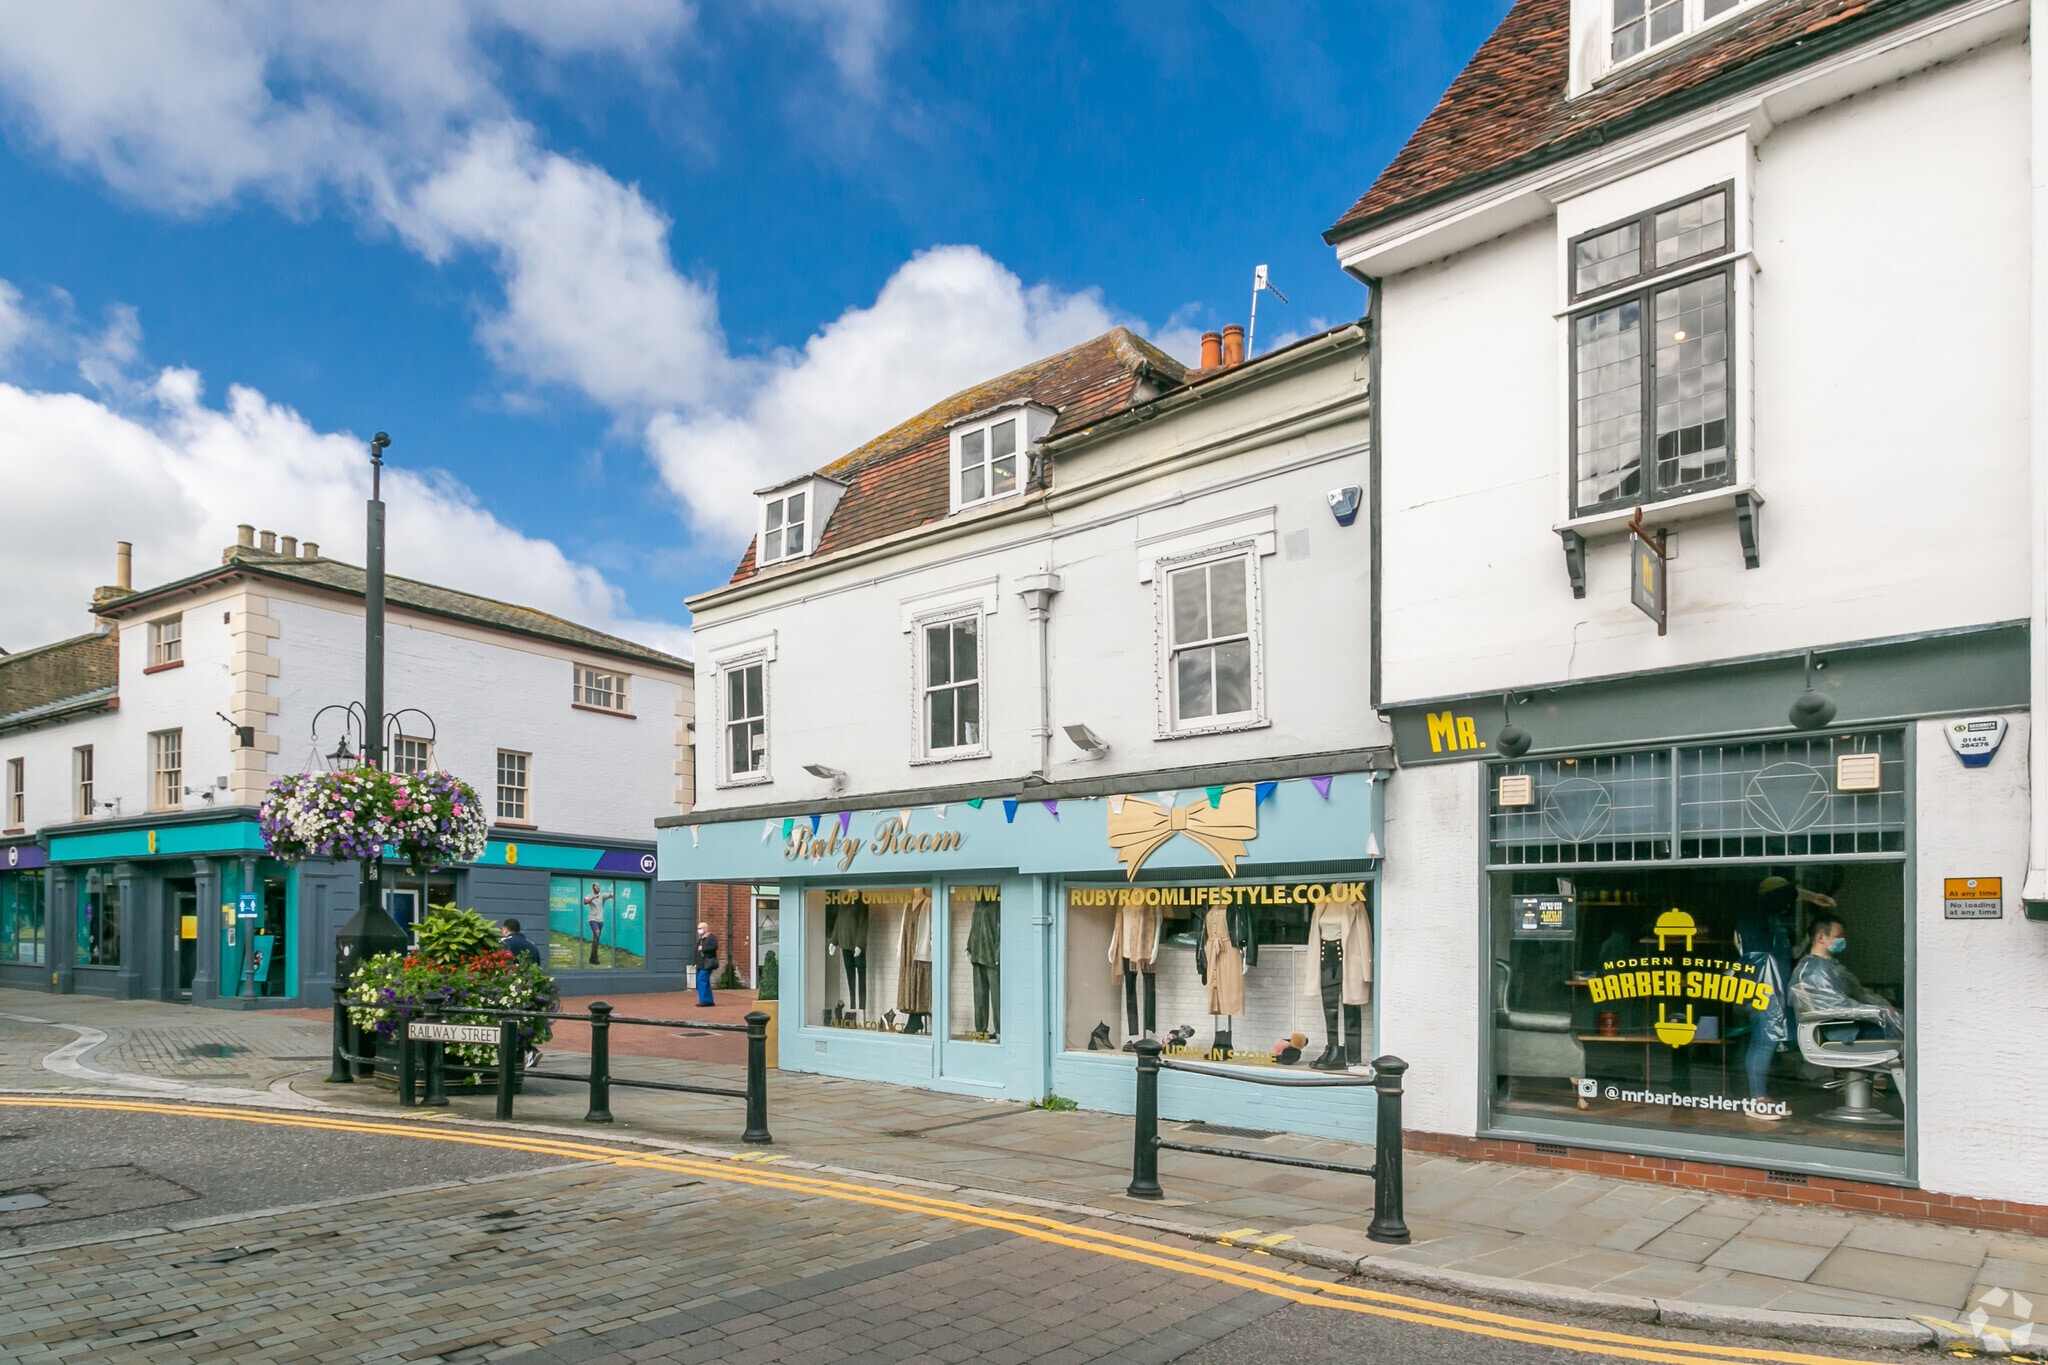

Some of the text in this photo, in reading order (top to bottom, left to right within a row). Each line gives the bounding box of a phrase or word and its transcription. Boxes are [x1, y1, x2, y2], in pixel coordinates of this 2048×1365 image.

[1426, 711, 1486, 753] MR.
[783, 816, 968, 872] Ruby Room
[825, 888, 913, 905] SHOP ONLINE
[955, 886, 1001, 902] WWW.
[1071, 882, 1366, 907] RUBYROOMLIFESTYLE.CO.UK
[1604, 957, 1755, 973] MODERN BRITISH
[1587, 970, 1773, 1011] BARBER SHOPS
[410, 1025, 499, 1042] RAILWAY STREET
[1207, 1047, 1224, 1060] IN
[1227, 1049, 1277, 1066] STORE
